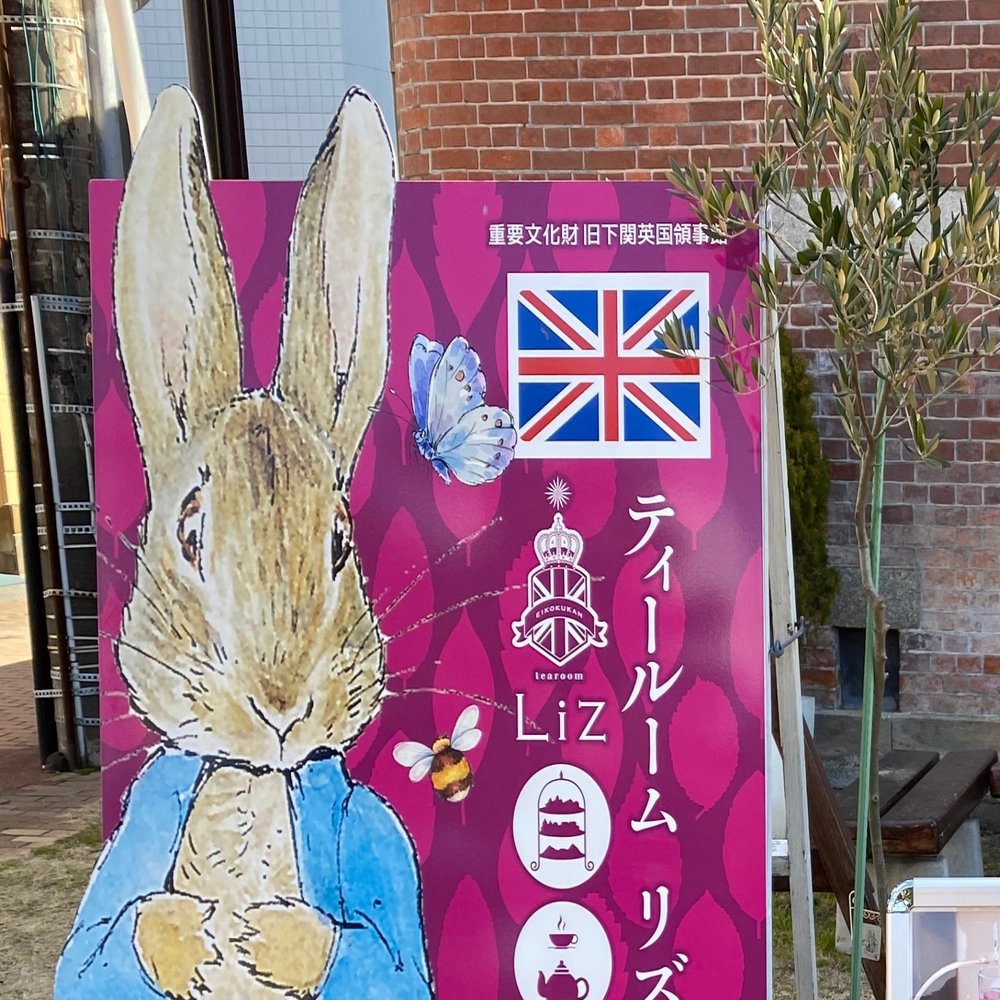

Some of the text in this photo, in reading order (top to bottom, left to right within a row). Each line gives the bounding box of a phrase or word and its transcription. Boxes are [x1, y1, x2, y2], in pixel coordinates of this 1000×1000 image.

[488, 223, 579, 246] 重要文化財
[535, 605, 584, 618] EIKOKUKAN
[621, 494, 684, 834] ティールーム
[535, 671, 584, 680] tearoom
